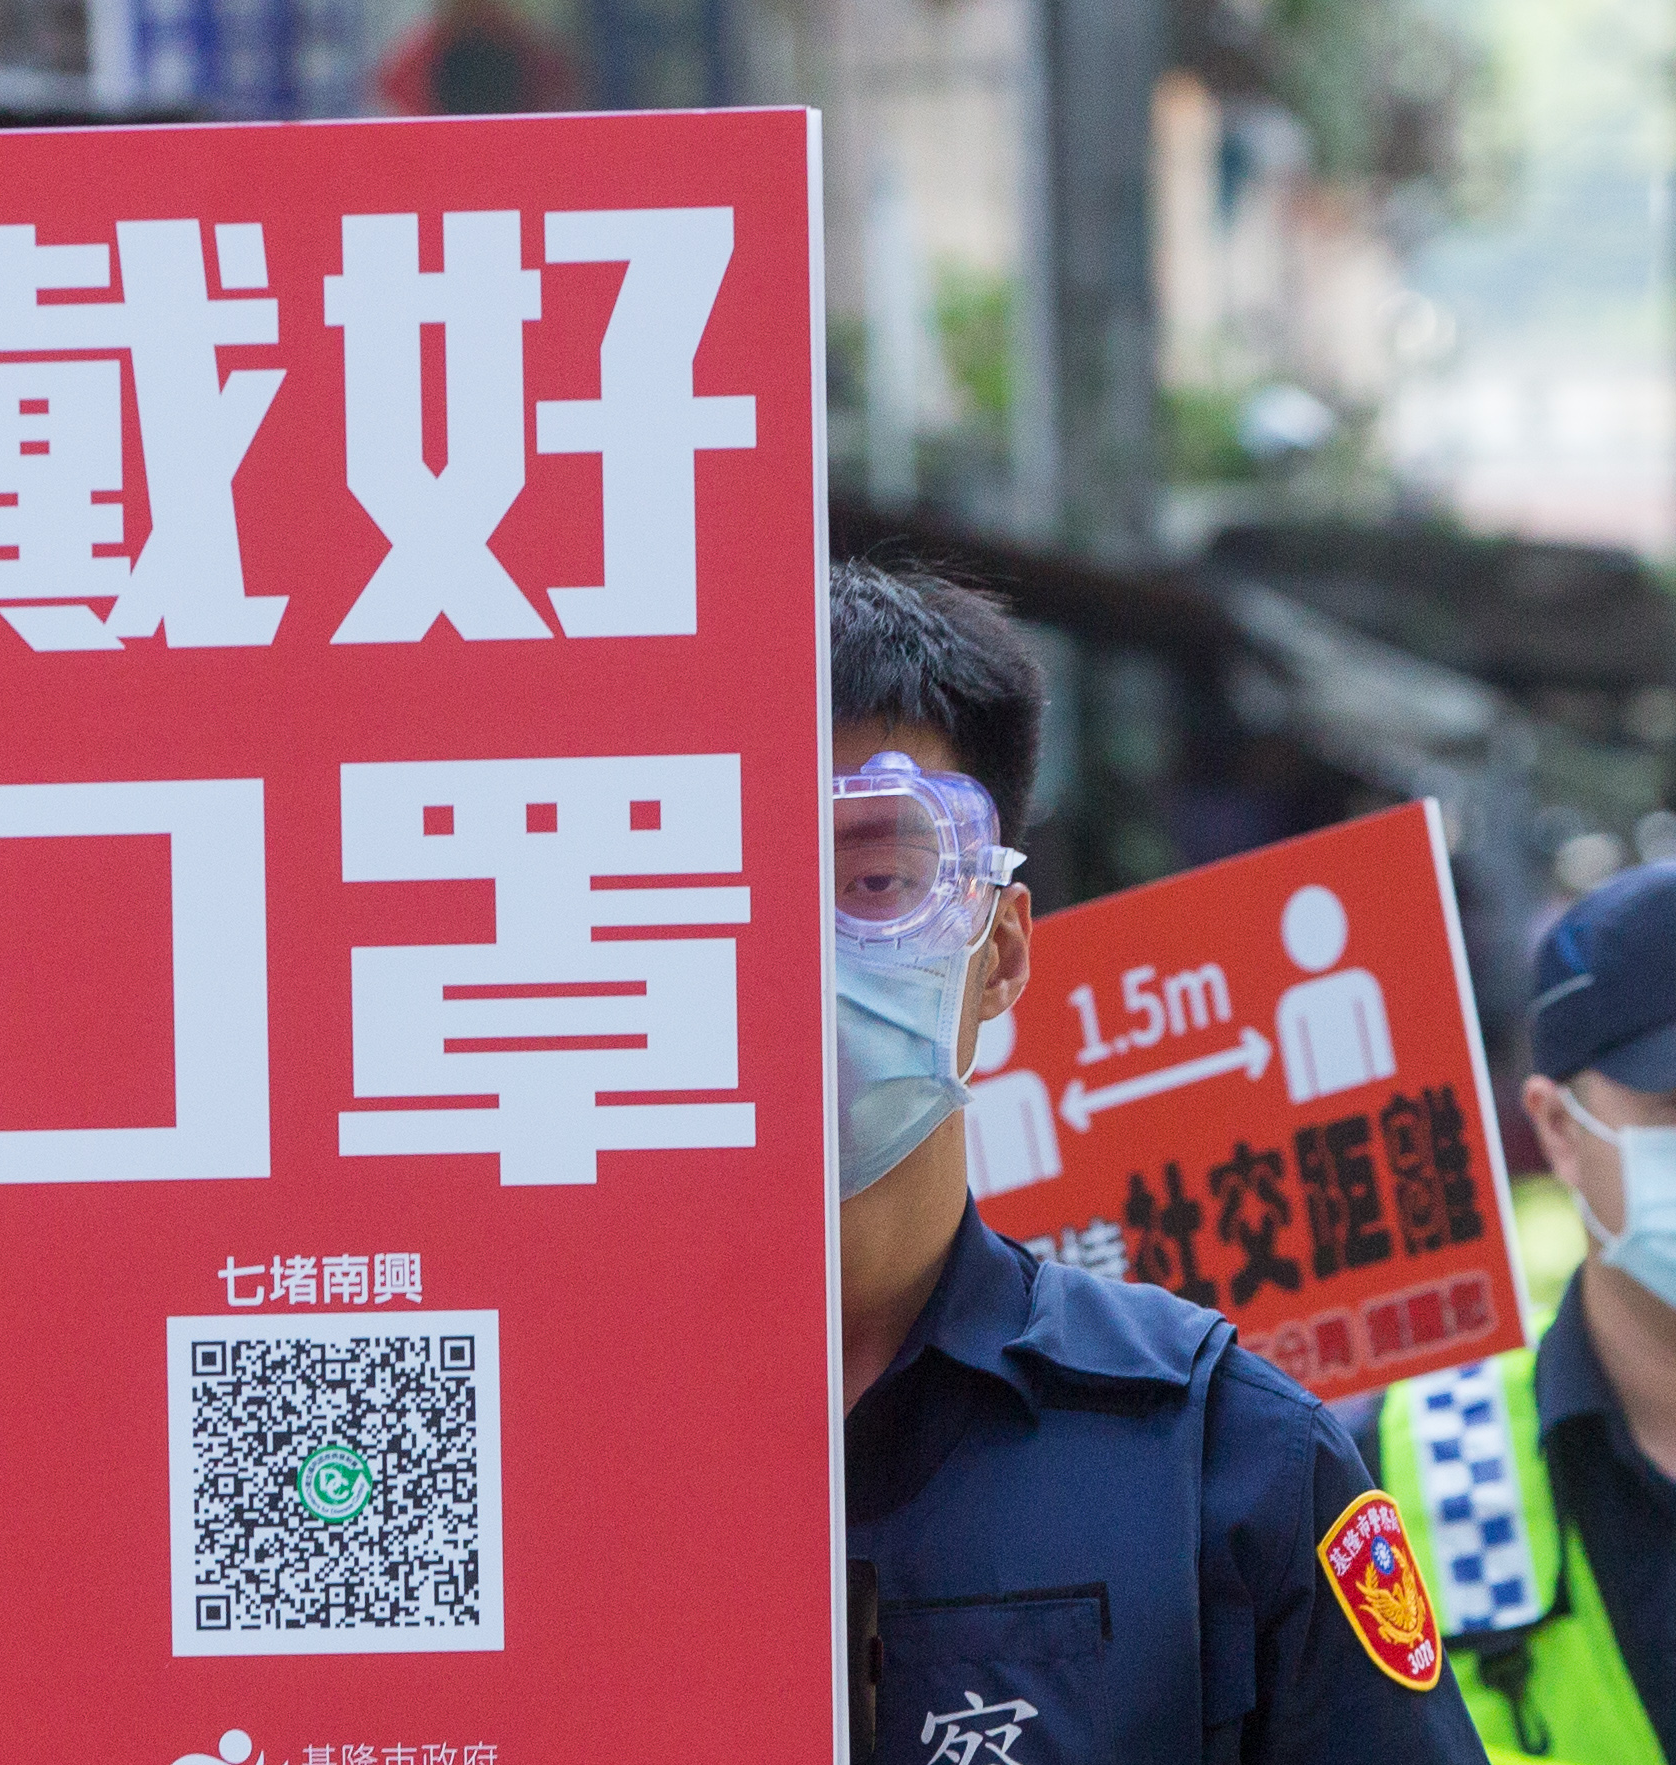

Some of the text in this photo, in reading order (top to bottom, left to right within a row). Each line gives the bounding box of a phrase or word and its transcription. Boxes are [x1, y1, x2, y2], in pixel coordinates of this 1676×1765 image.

[1068, 964, 1232, 1065] 1.5m
[217, 1252, 423, 1307] 七堵南興
